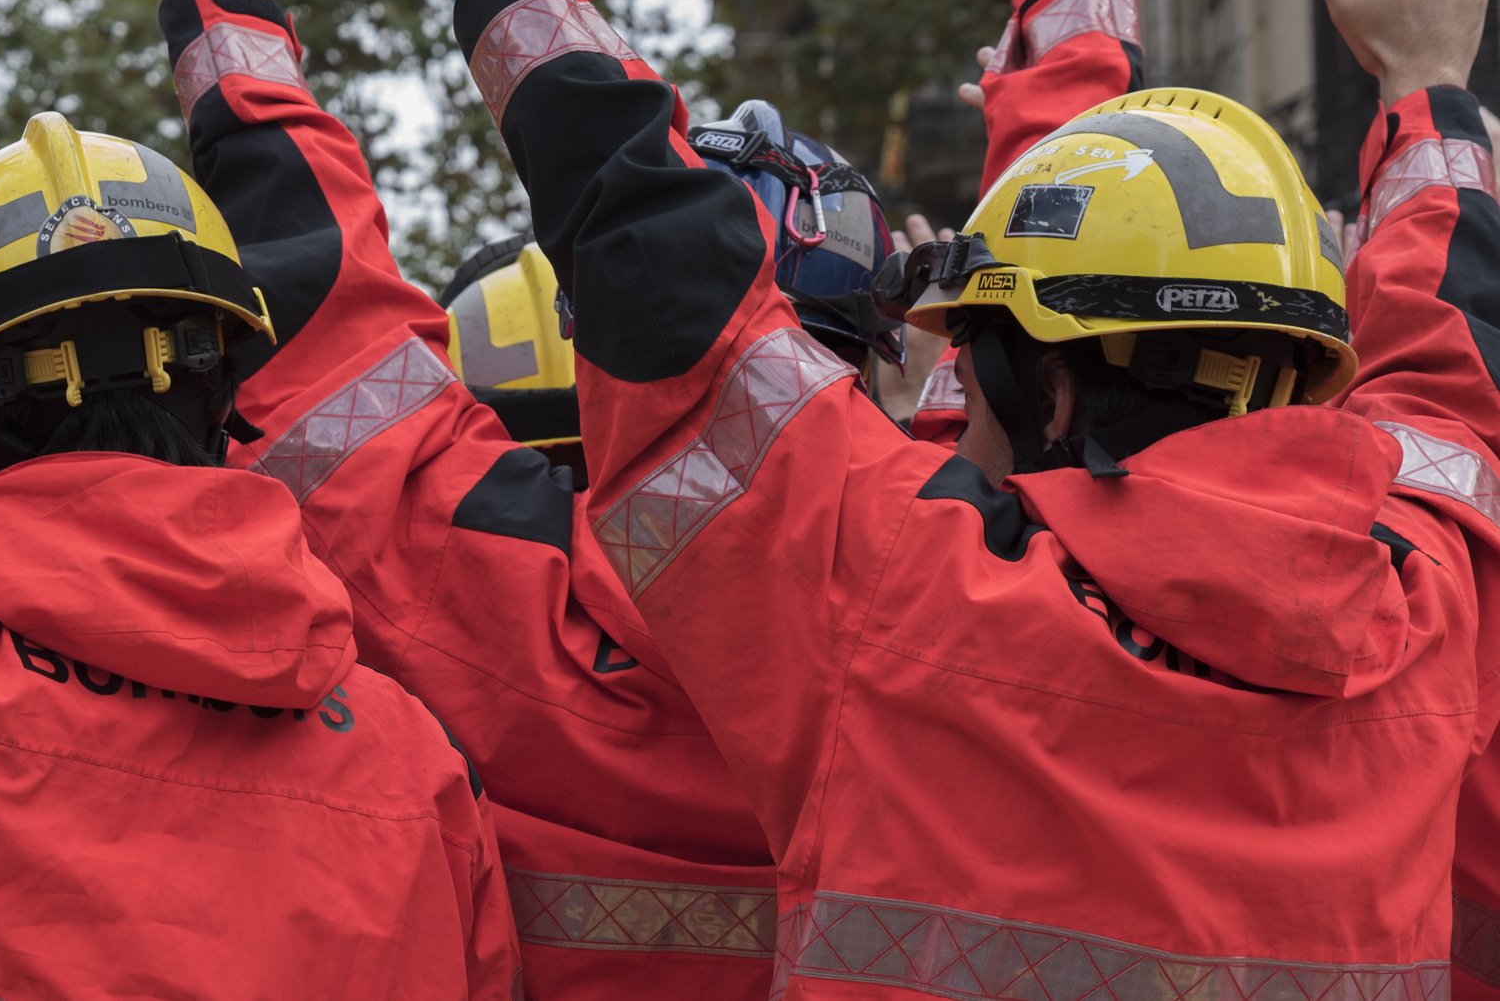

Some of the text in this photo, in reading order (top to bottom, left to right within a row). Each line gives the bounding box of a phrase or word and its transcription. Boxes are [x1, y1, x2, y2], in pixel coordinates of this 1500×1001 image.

[1090, 147, 1117, 159] EN
[107, 195, 180, 216] bombers
[979, 274, 1014, 289] MSA
[975, 291, 1015, 299] GALLET
[1160, 288, 1240, 313] PETZL
